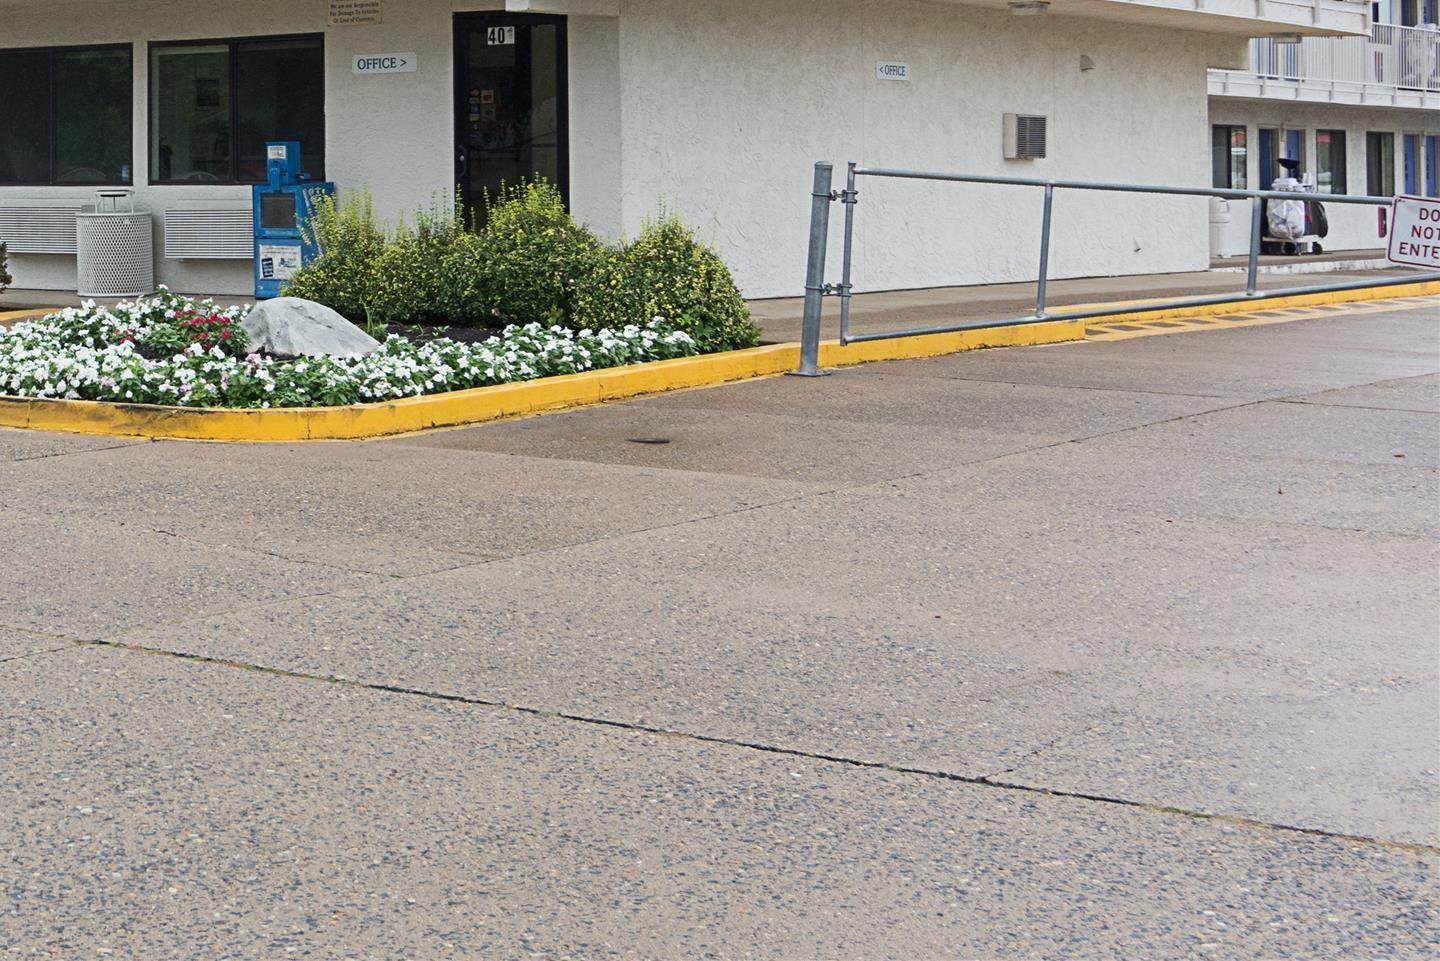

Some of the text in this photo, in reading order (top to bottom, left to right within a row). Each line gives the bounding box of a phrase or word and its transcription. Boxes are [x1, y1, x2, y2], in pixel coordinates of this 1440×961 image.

[357, 57, 397, 70] OFFICE
[884, 64, 906, 76] OFFICE
[1419, 207, 1440, 222] DO
[1411, 225, 1440, 241] NOT
